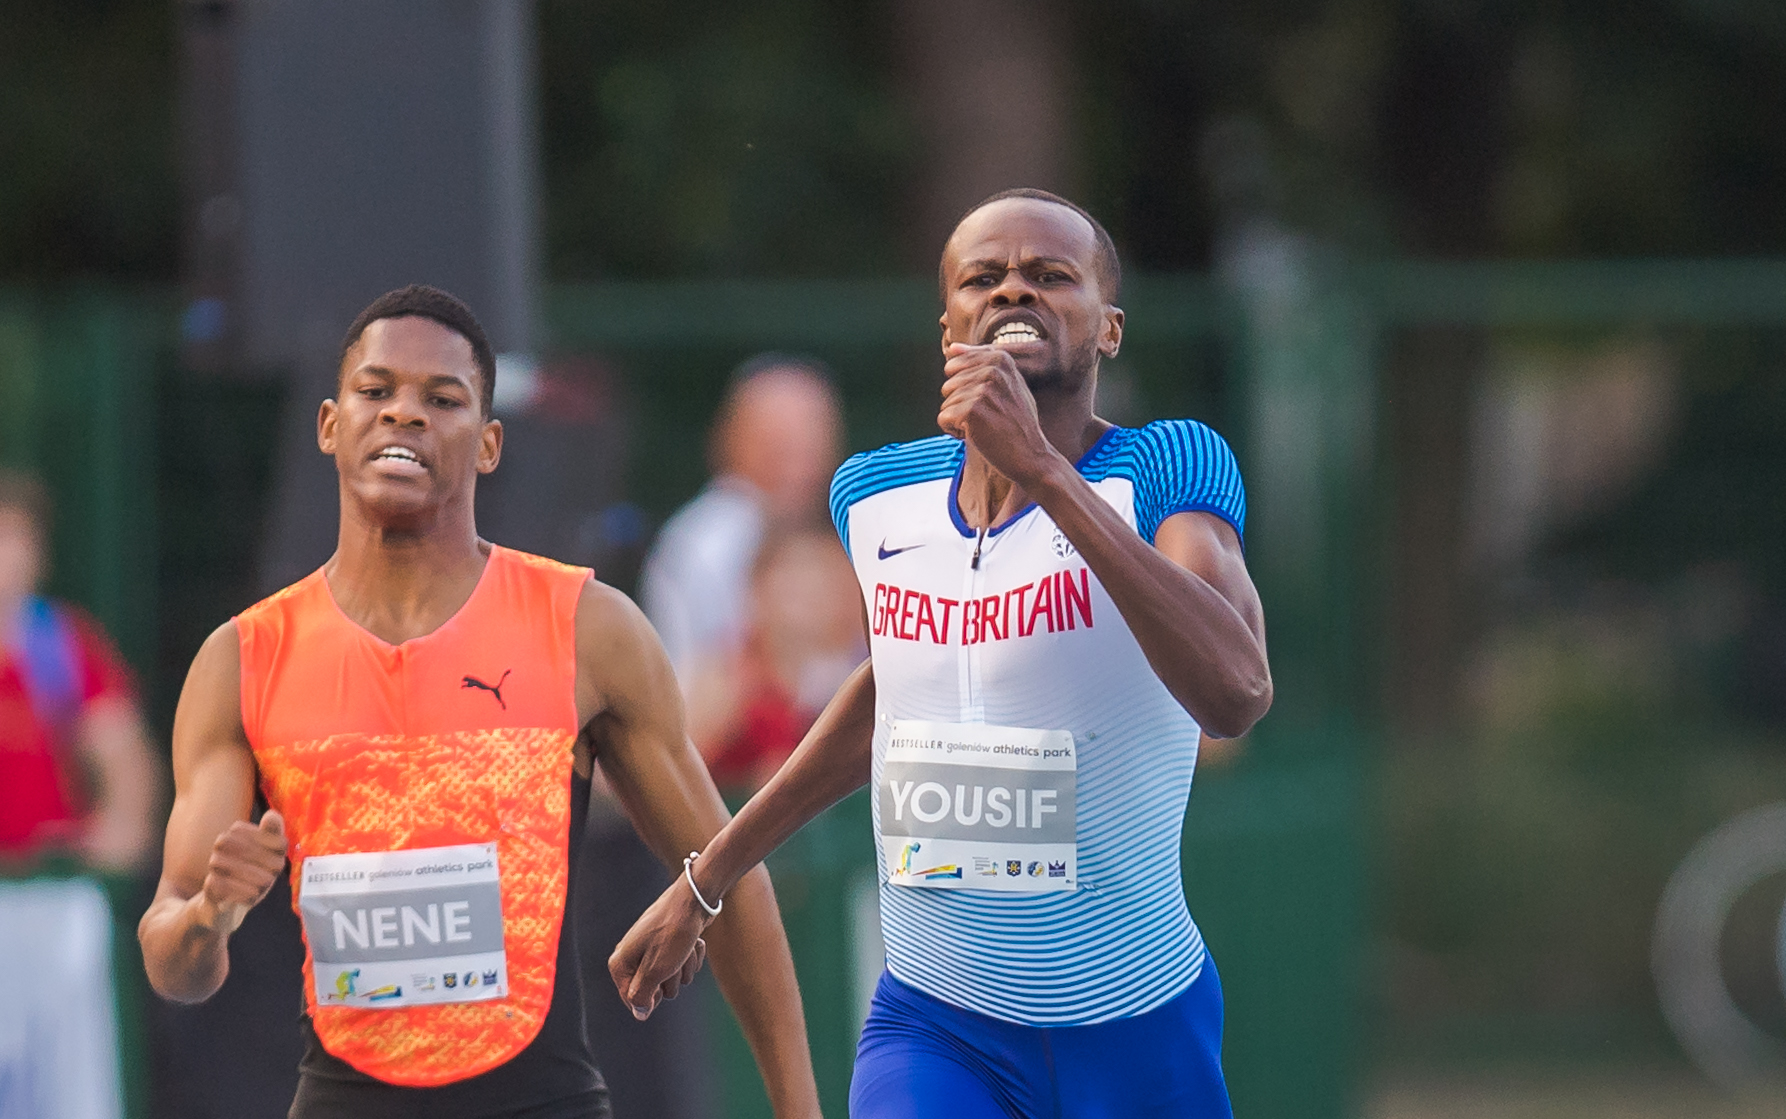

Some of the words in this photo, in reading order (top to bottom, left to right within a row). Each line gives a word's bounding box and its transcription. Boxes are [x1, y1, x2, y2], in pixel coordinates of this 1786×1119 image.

[872, 582, 959, 645] GREAT
[961, 567, 1094, 646] BRITAIN
[891, 738, 943, 750] BESTSELLER
[992, 743, 1040, 757] athletics
[1043, 747, 1072, 760] park
[889, 780, 1058, 829] YOUSIF
[307, 871, 365, 882] BESTSELLER
[415, 862, 464, 875] athletics
[467, 860, 493, 872] park
[332, 901, 472, 950] NENE
